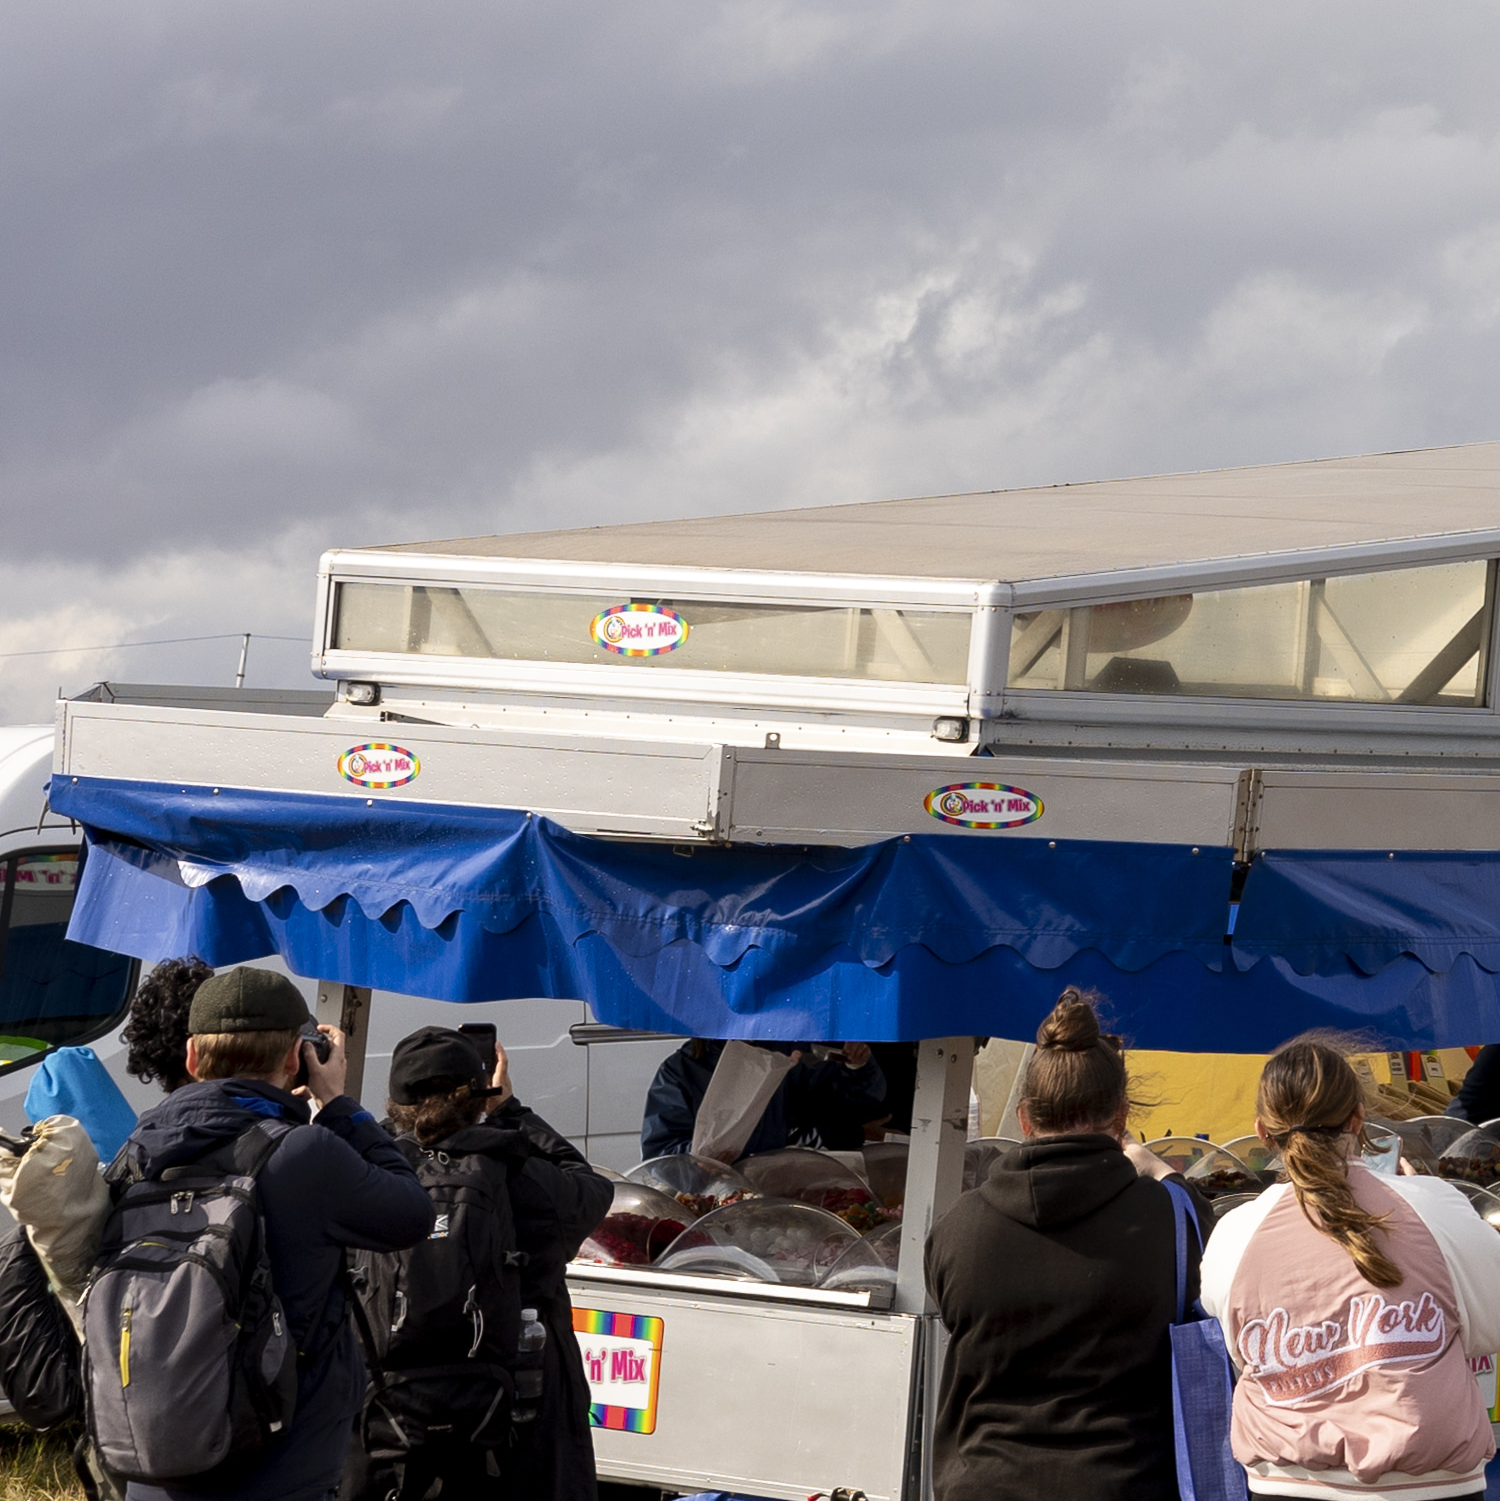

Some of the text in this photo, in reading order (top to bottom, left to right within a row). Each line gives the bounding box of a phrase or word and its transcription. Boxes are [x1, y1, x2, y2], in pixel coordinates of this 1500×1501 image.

[621, 625, 642, 638] Pick
[658, 622, 677, 636] Mix
[364, 761, 382, 774] Pick
[394, 758, 411, 771] Mix
[963, 800, 988, 812] Pick
[1007, 799, 1030, 812] Mix
[1242, 1294, 1440, 1368] New York
[611, 1349, 645, 1381] Mix
